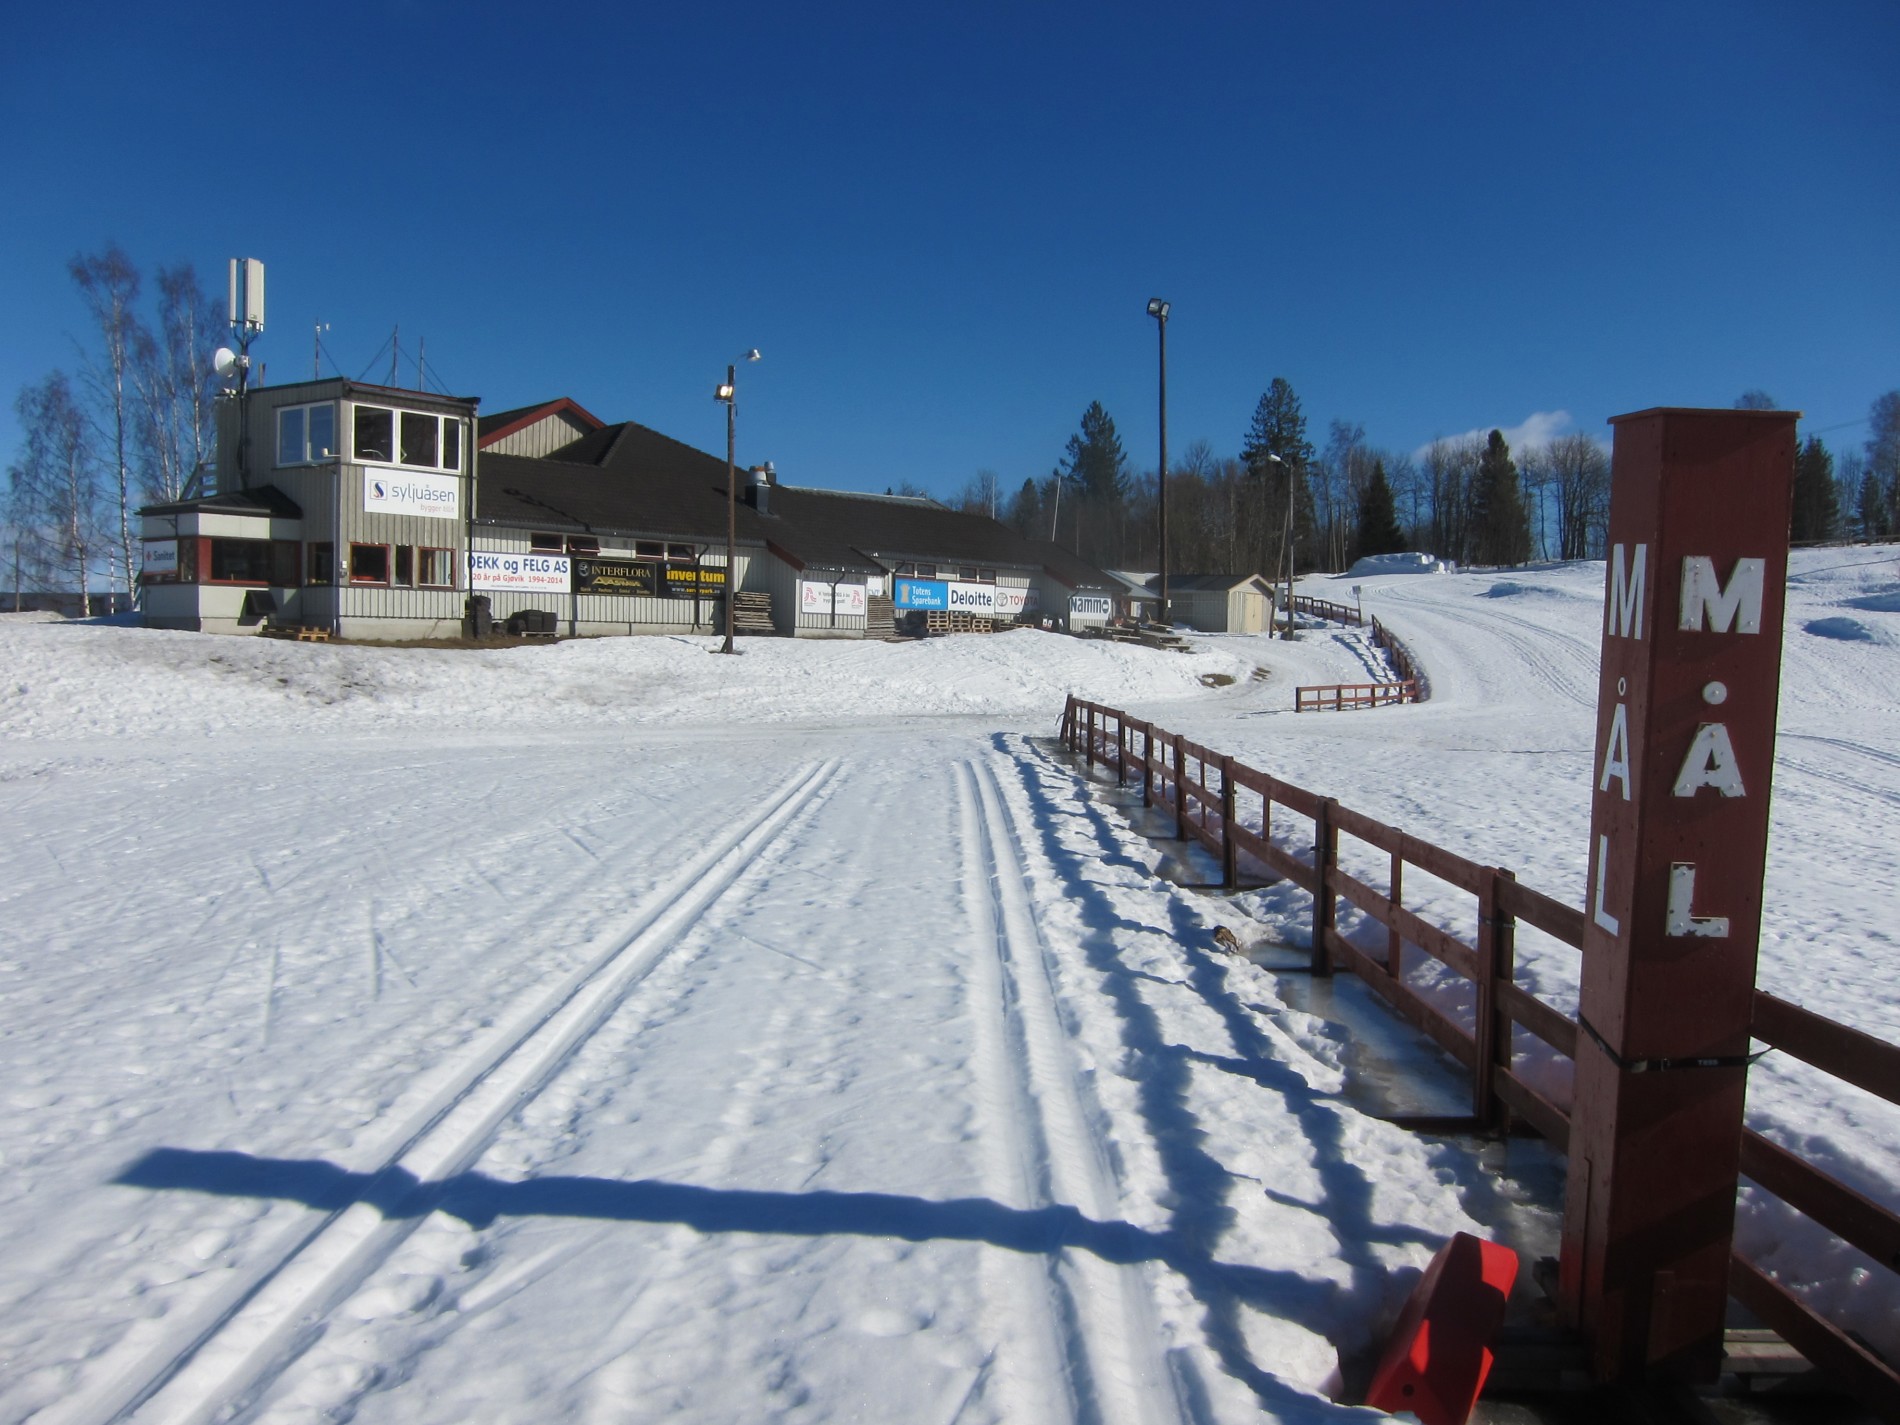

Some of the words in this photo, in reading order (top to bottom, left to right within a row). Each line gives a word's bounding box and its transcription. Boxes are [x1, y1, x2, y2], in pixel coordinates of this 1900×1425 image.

[391, 483, 455, 503] syljuåsen
[153, 550, 175, 561] Sanitet
[468, 555, 500, 570] DEKK
[503, 559, 519, 575] og
[523, 558, 550, 573] FELG
[553, 560, 568, 574] AS
[591, 565, 651, 578] INTERFLORA
[473, 573, 482, 581] 20
[483, 573, 491, 581] år
[492, 574, 501, 583] på
[502, 575, 524, 584] Gjøvik
[528, 576, 563, 585] 1994-2014
[911, 585, 931, 596] Totens
[911, 595, 942, 607] Sparebank
[951, 589, 992, 607] Deloitte
[1009, 595, 1039, 606] TOYOTA
[1594, 543, 1647, 937] MÅL
[1665, 555, 1766, 938] MÅL
